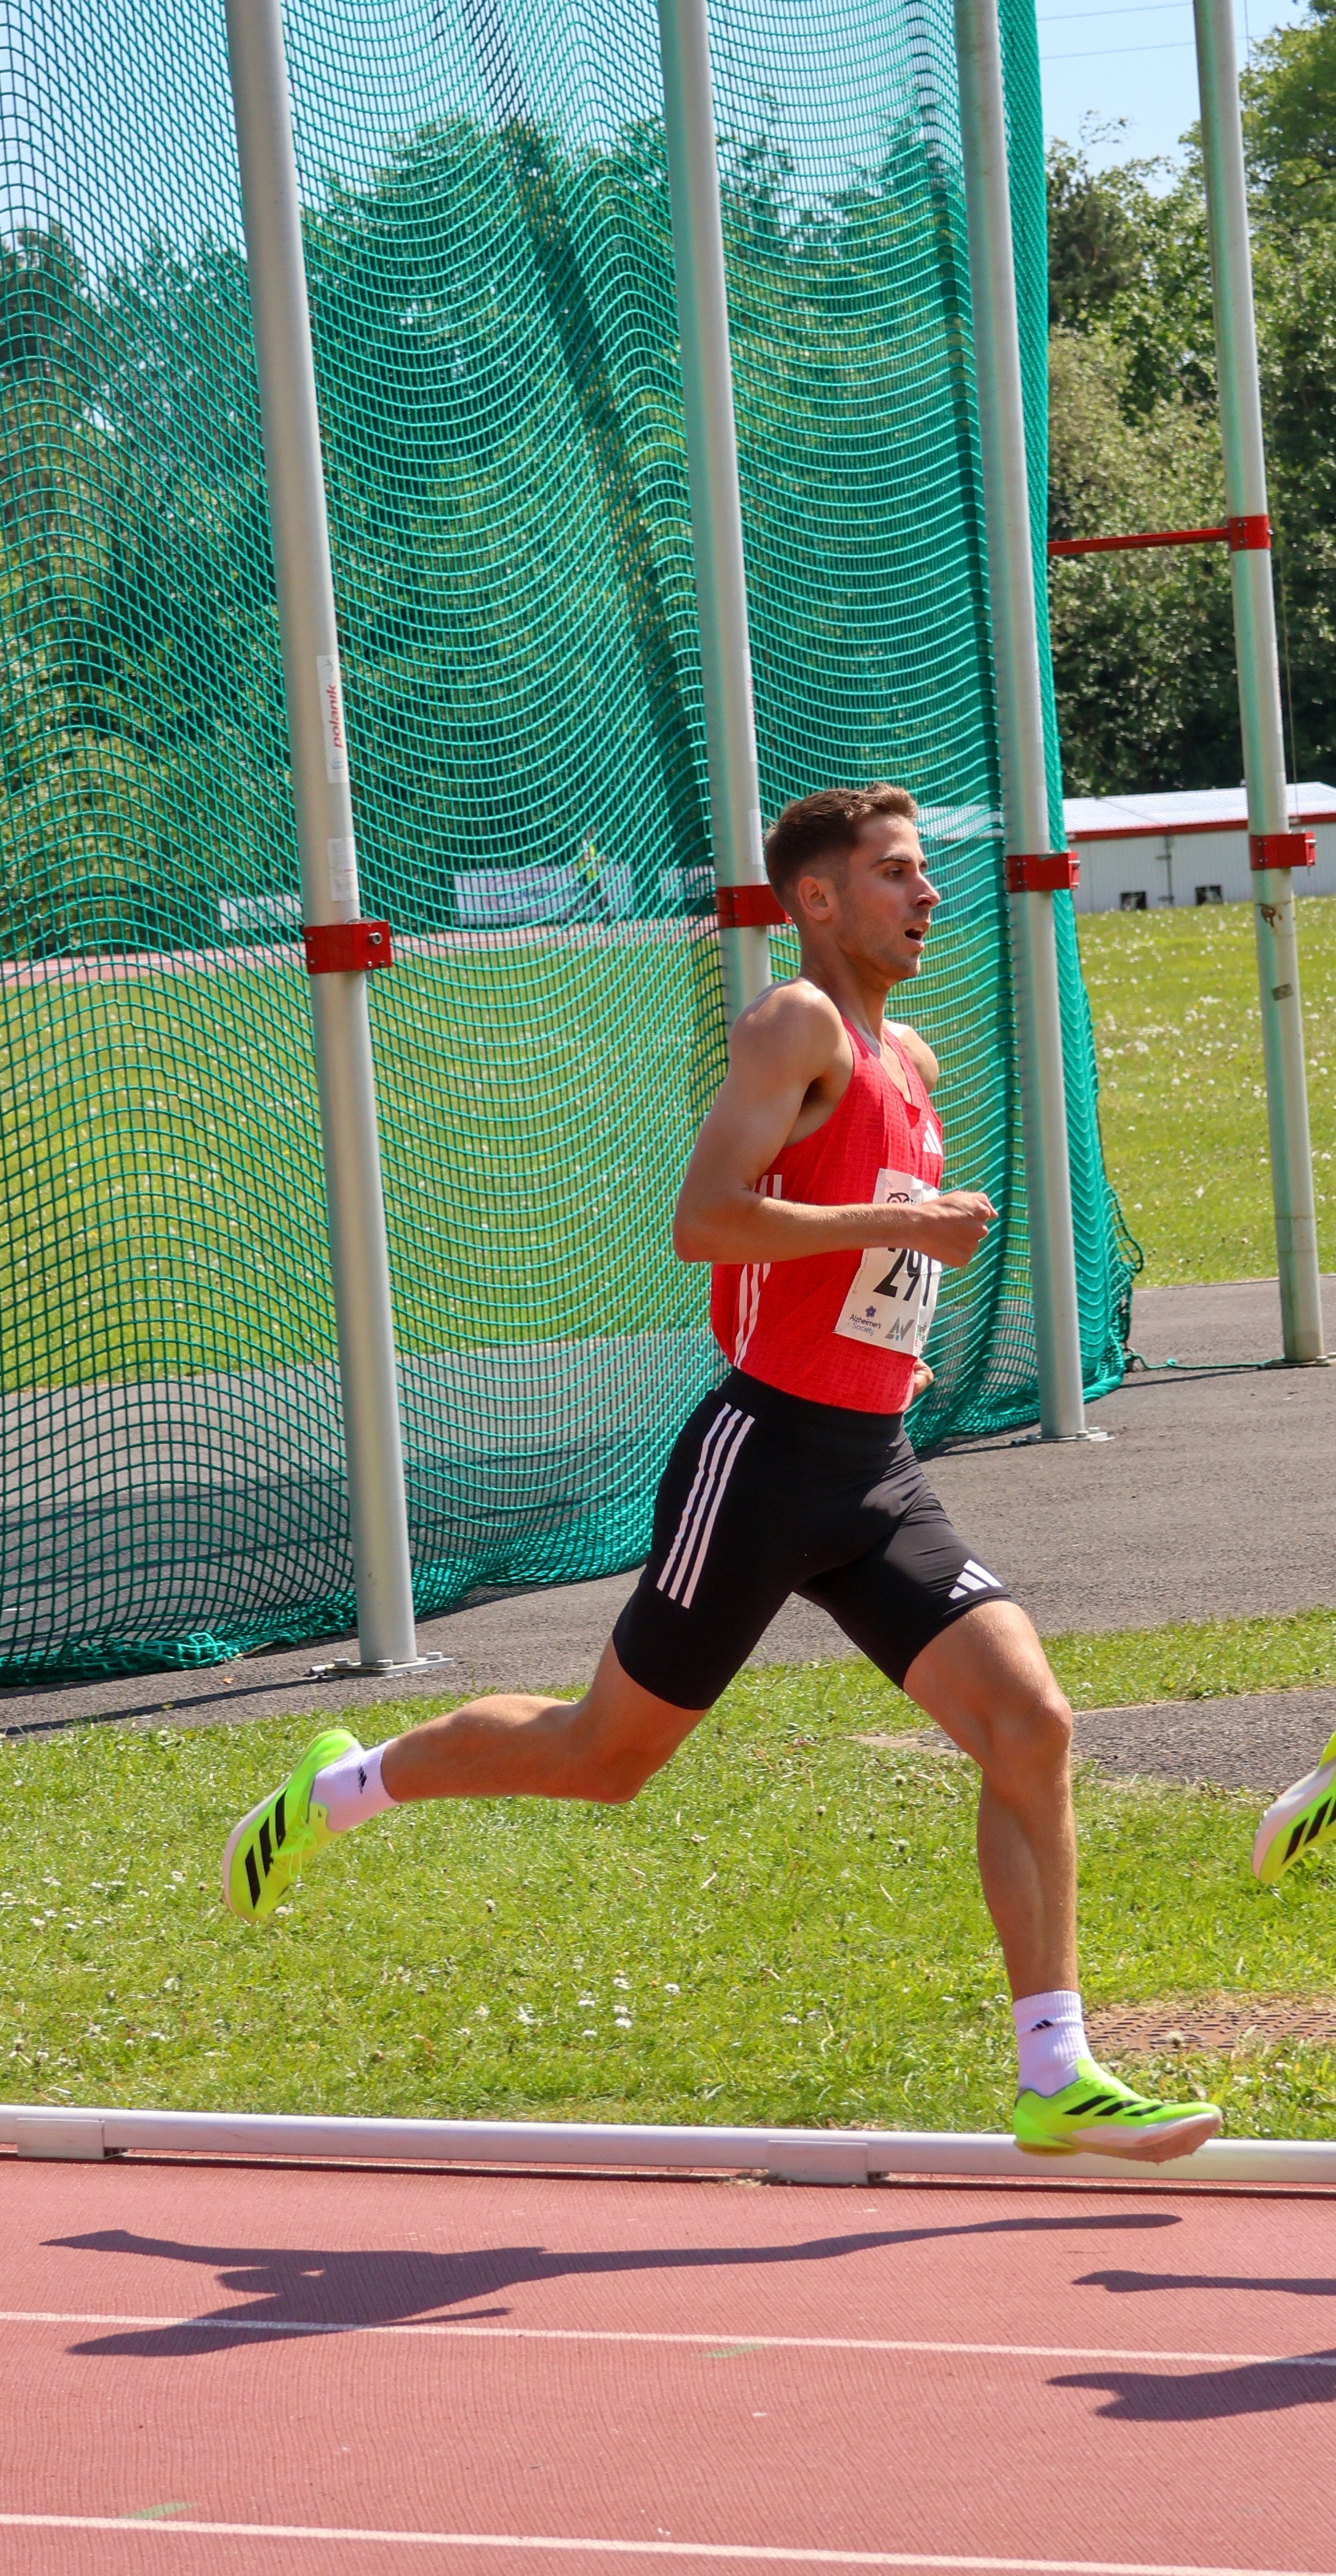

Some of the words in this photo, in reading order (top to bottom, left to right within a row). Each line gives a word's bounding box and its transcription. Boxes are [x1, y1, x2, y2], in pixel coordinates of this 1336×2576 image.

[326, 684, 343, 748] polanik
[849, 1314, 882, 1329] Alzheimer's
[852, 1322, 875, 1336] Society
